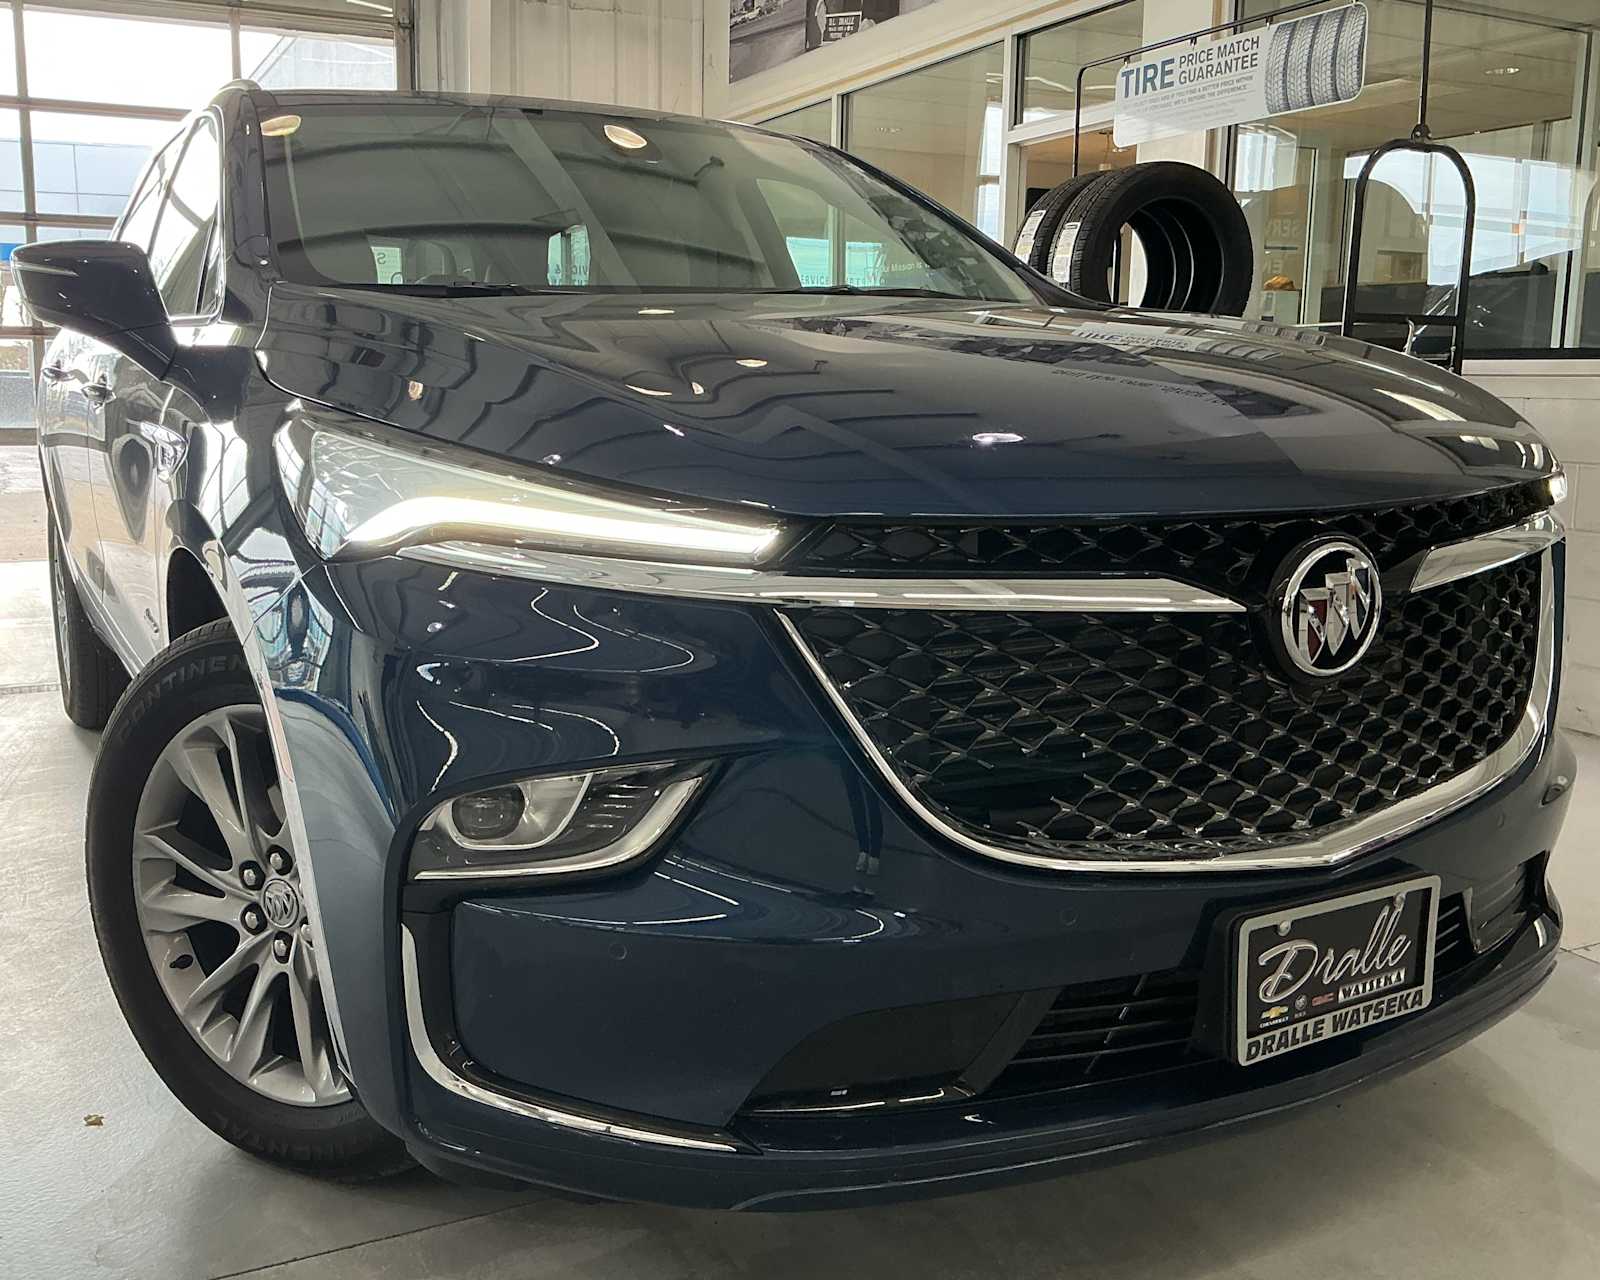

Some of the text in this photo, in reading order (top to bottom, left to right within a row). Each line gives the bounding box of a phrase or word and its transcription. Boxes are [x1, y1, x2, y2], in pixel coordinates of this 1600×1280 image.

[1121, 36, 1260, 98] TIRE PRICE MATCH
[1178, 52, 1259, 85] GUARANTEE
[1258, 904, 1412, 1003] Dralle
[1342, 971, 1402, 998] WATSEKA
[1246, 990, 1423, 1061] DRALLE WATSEKA
